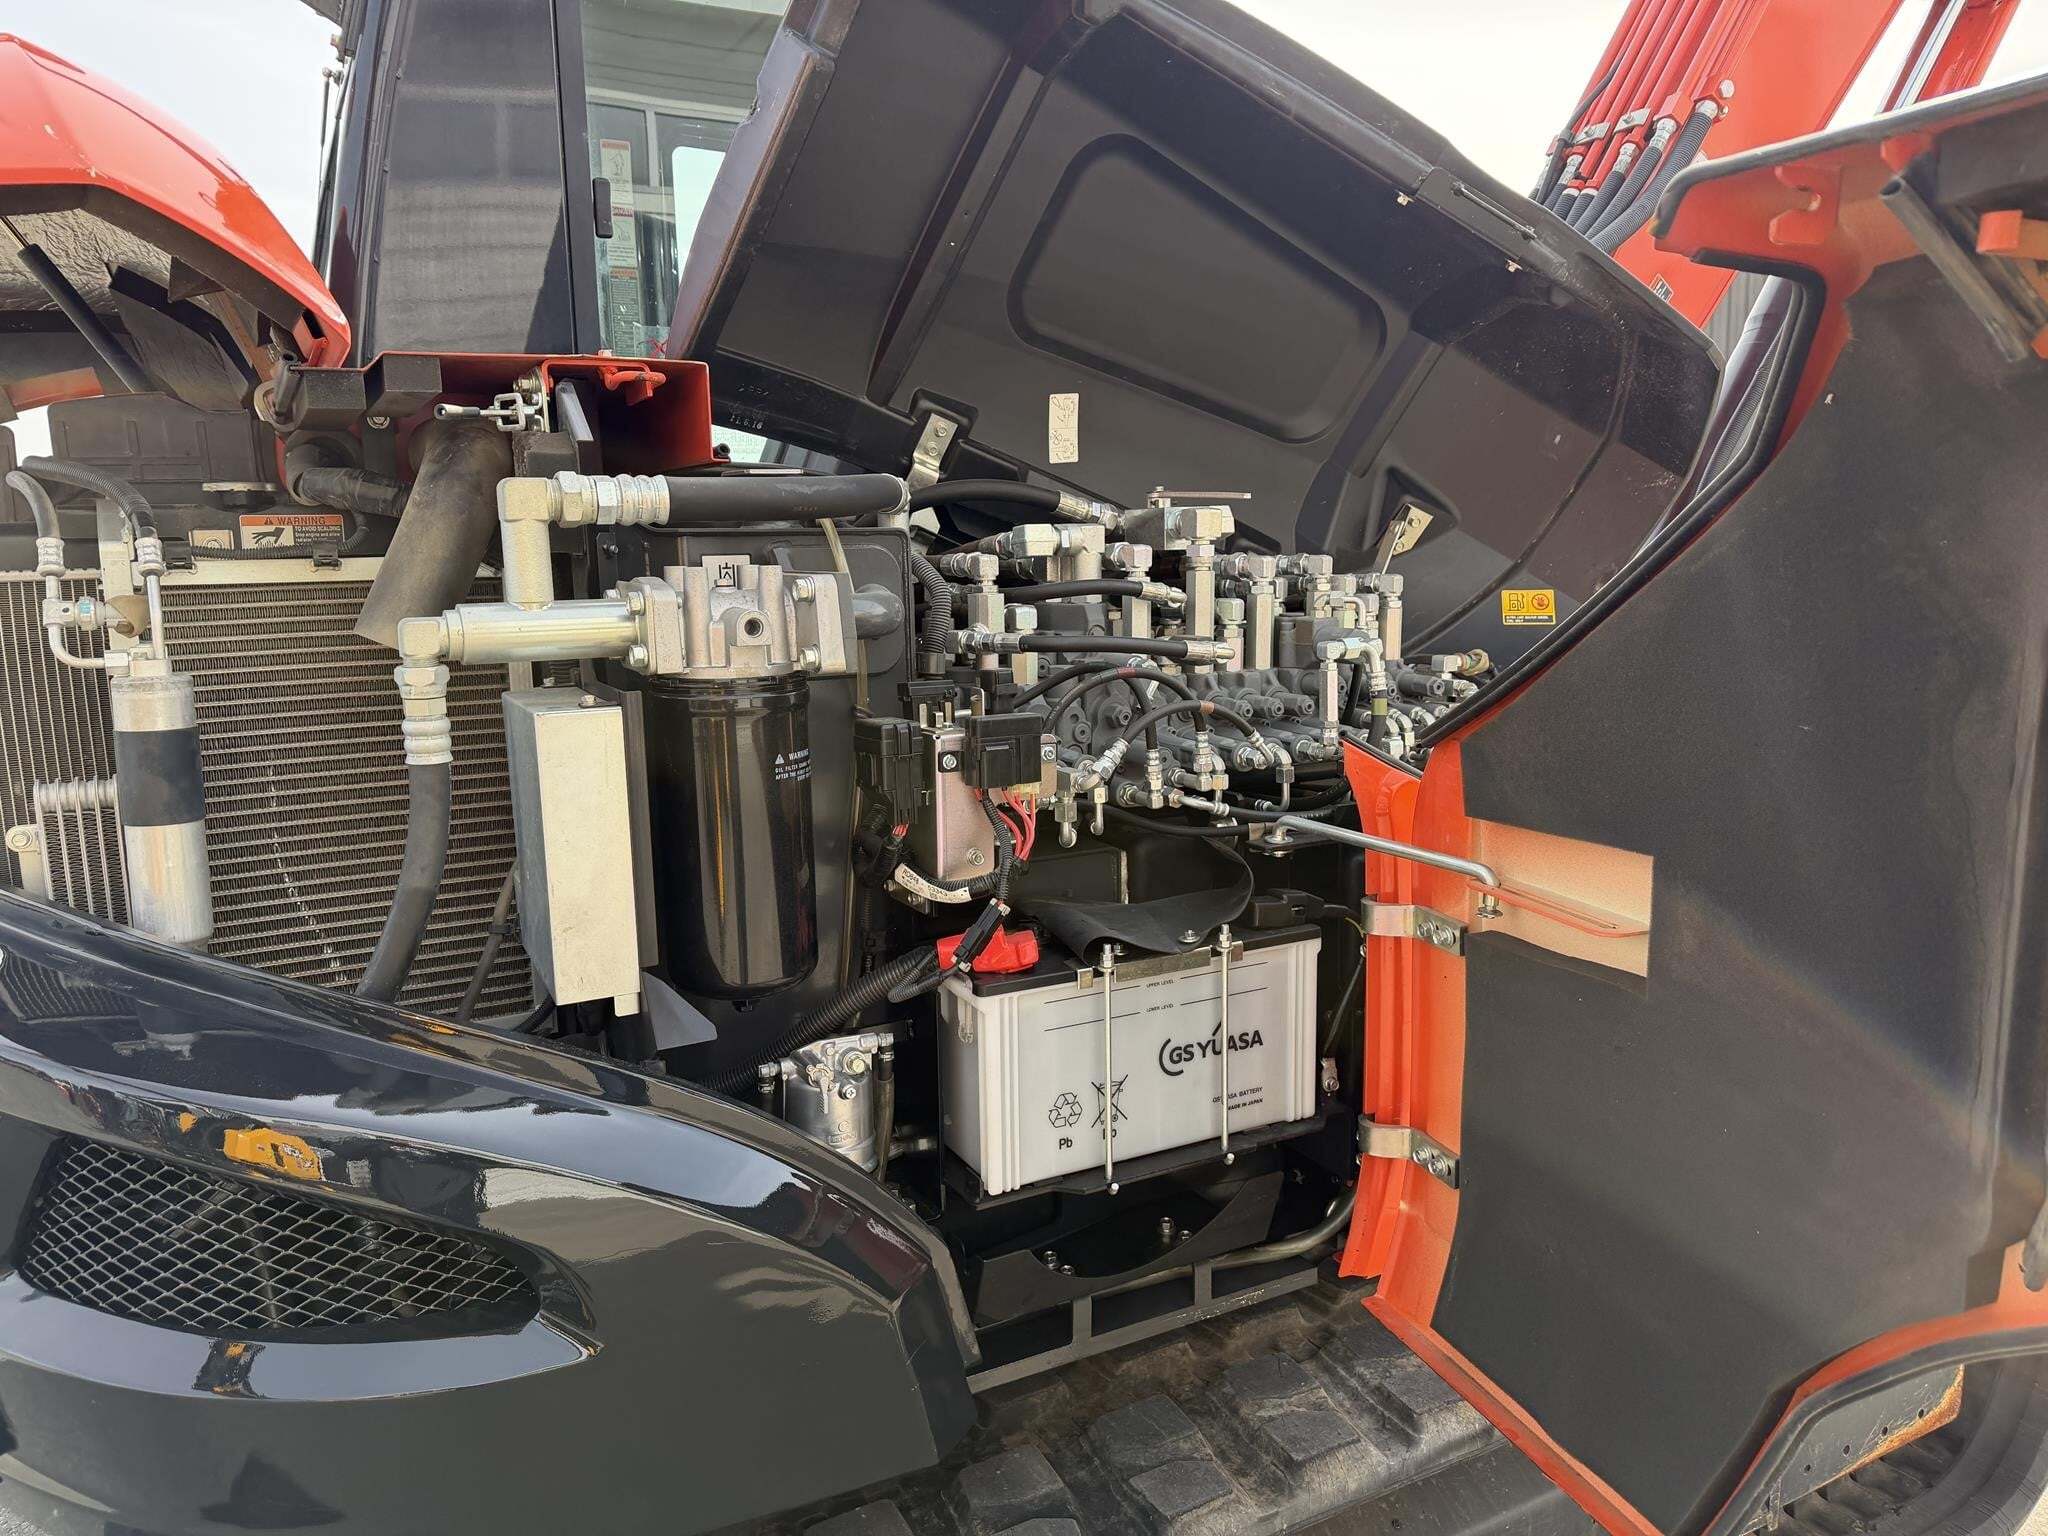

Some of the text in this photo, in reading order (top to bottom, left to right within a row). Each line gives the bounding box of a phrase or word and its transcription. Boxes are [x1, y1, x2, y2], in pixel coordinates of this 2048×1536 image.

[277, 516, 326, 525] WARNING
[1239, 1086, 1263, 1097] BATTERY
[1247, 1097, 1264, 1106] JAPAN
[1059, 1137, 1073, 1150] Pb
